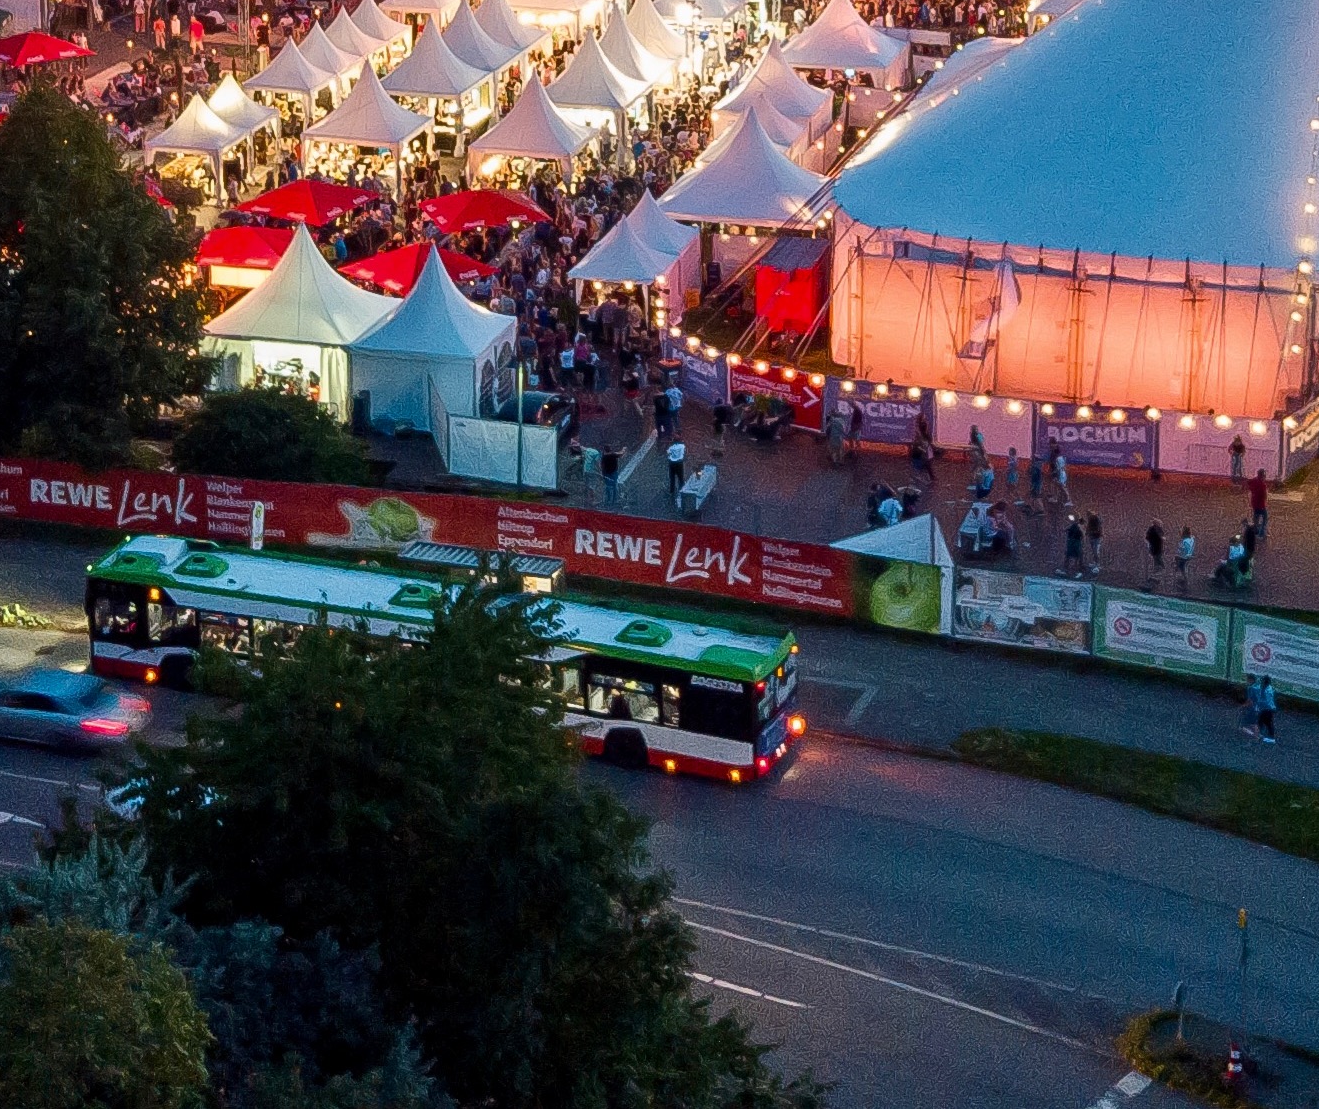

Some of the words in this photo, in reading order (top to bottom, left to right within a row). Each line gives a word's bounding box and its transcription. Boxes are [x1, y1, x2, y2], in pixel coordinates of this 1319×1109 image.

[1047, 425, 1147, 443] BOCHUM
[29, 478, 113, 511] REWE
[116, 478, 198, 527] Lenk
[574, 528, 662, 566] REWE
[665, 533, 752, 586] Lenk
